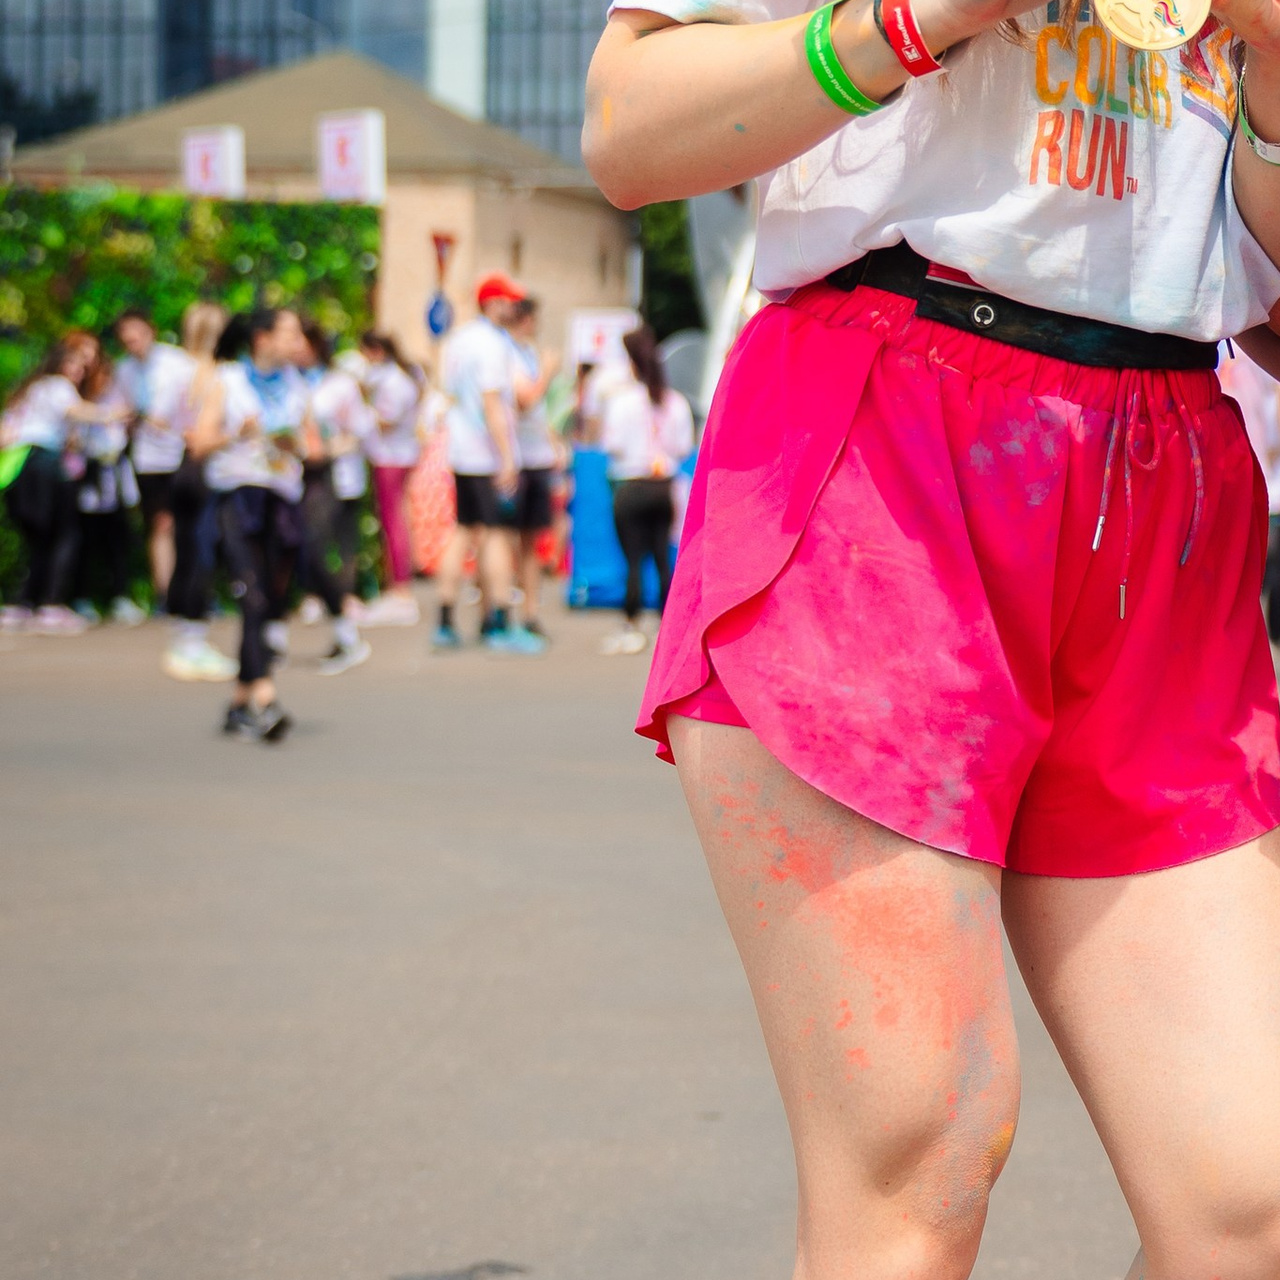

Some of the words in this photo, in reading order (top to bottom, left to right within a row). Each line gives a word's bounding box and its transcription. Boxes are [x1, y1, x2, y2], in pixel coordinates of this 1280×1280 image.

[894, 7, 912, 46] Kaufland
[818, 53, 835, 81] career
[1035, 24, 1173, 131] COLOR
[831, 80, 857, 105] colorful
